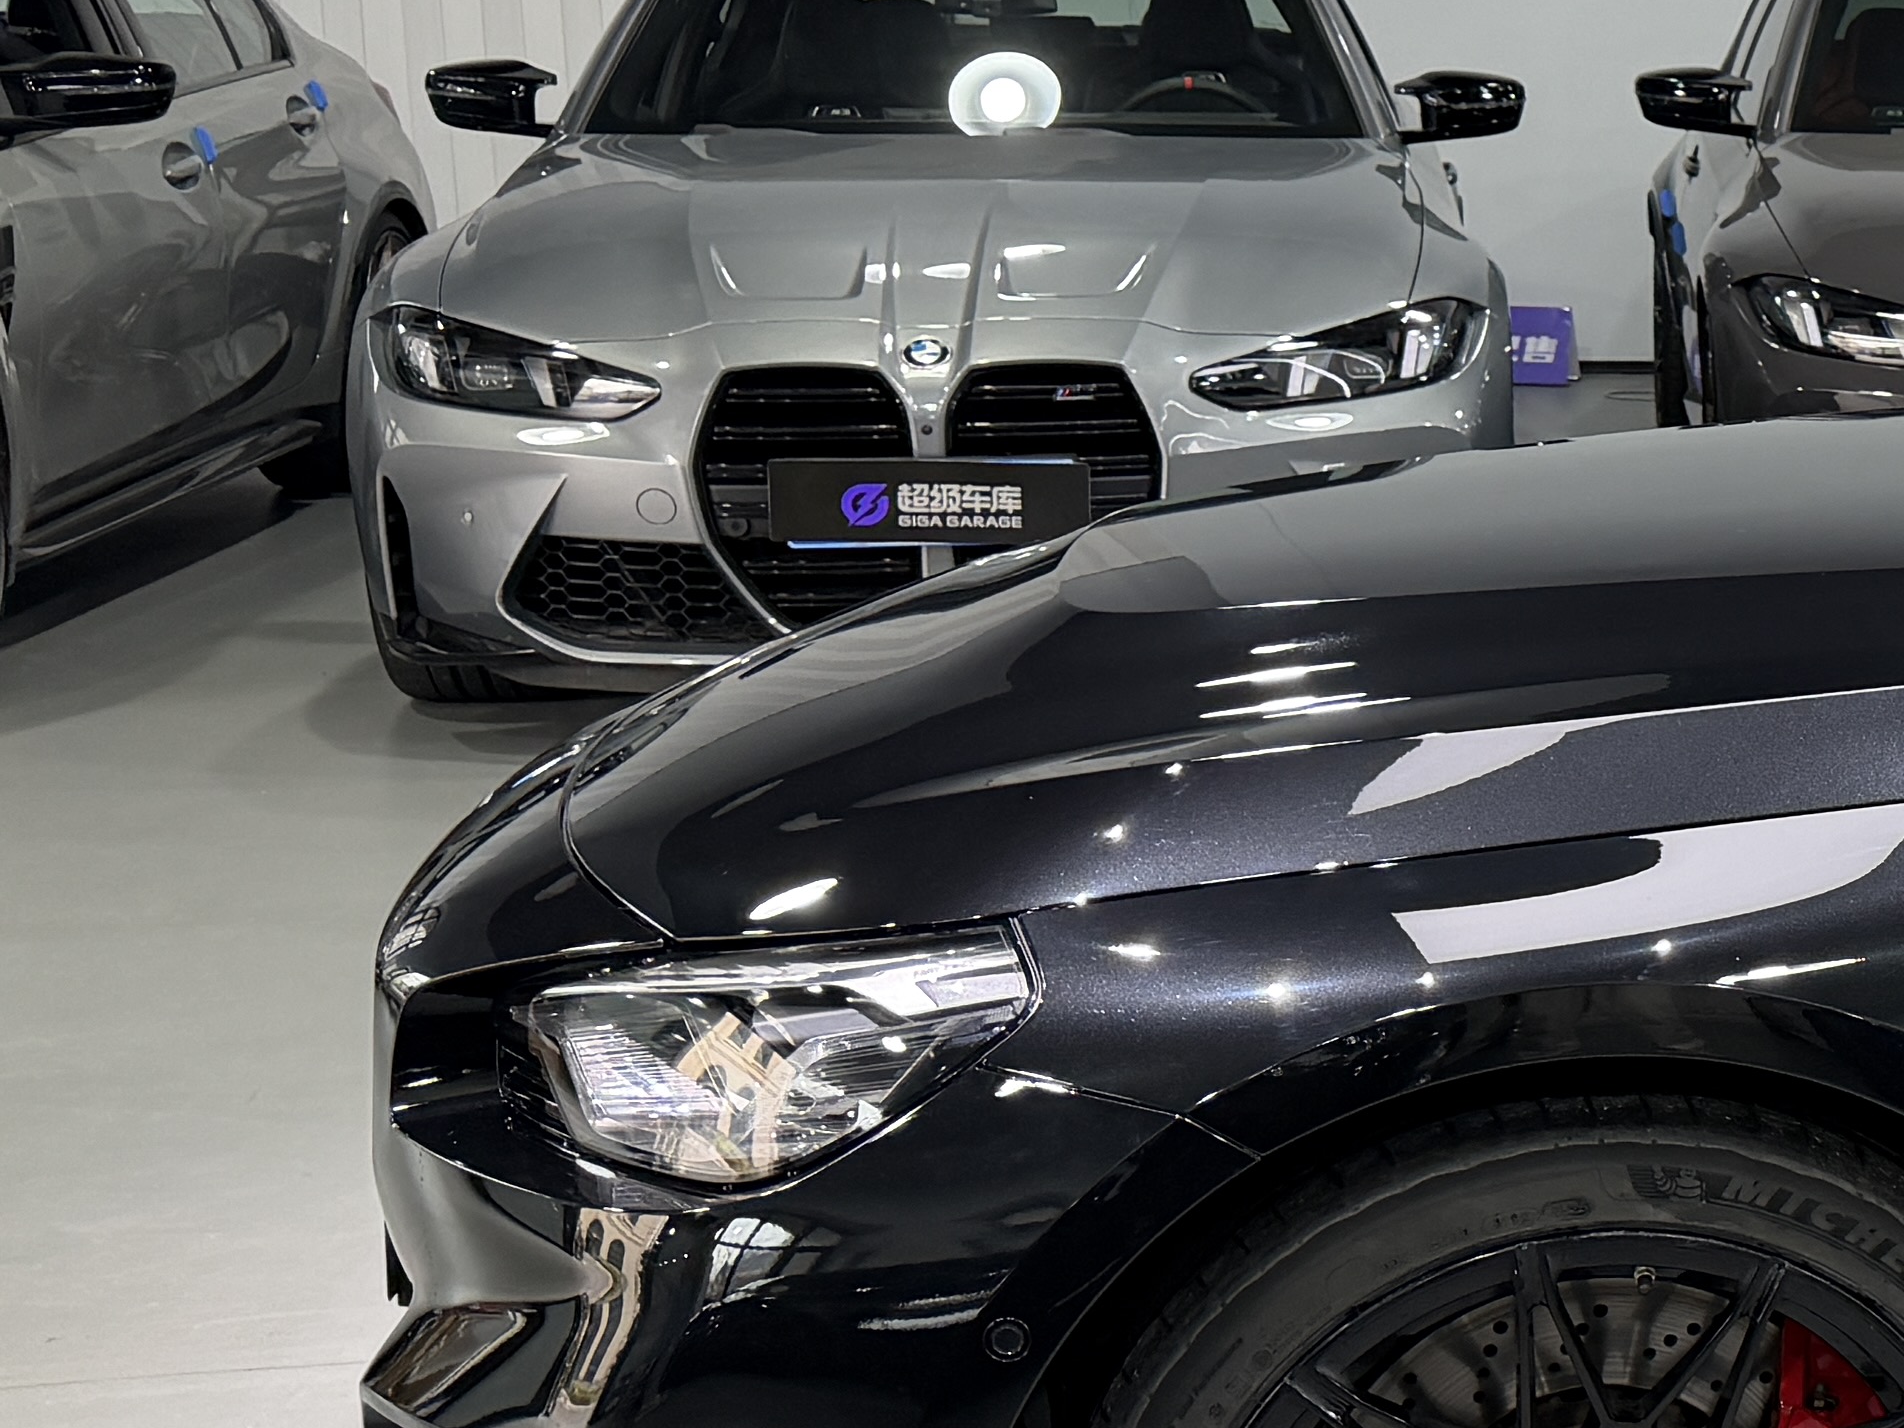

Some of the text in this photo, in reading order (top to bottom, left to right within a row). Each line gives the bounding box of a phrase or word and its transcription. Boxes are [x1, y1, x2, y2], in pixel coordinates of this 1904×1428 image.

[897, 483, 1023, 513] 超级车库
[898, 515, 1024, 529] GIGA GARAGE
